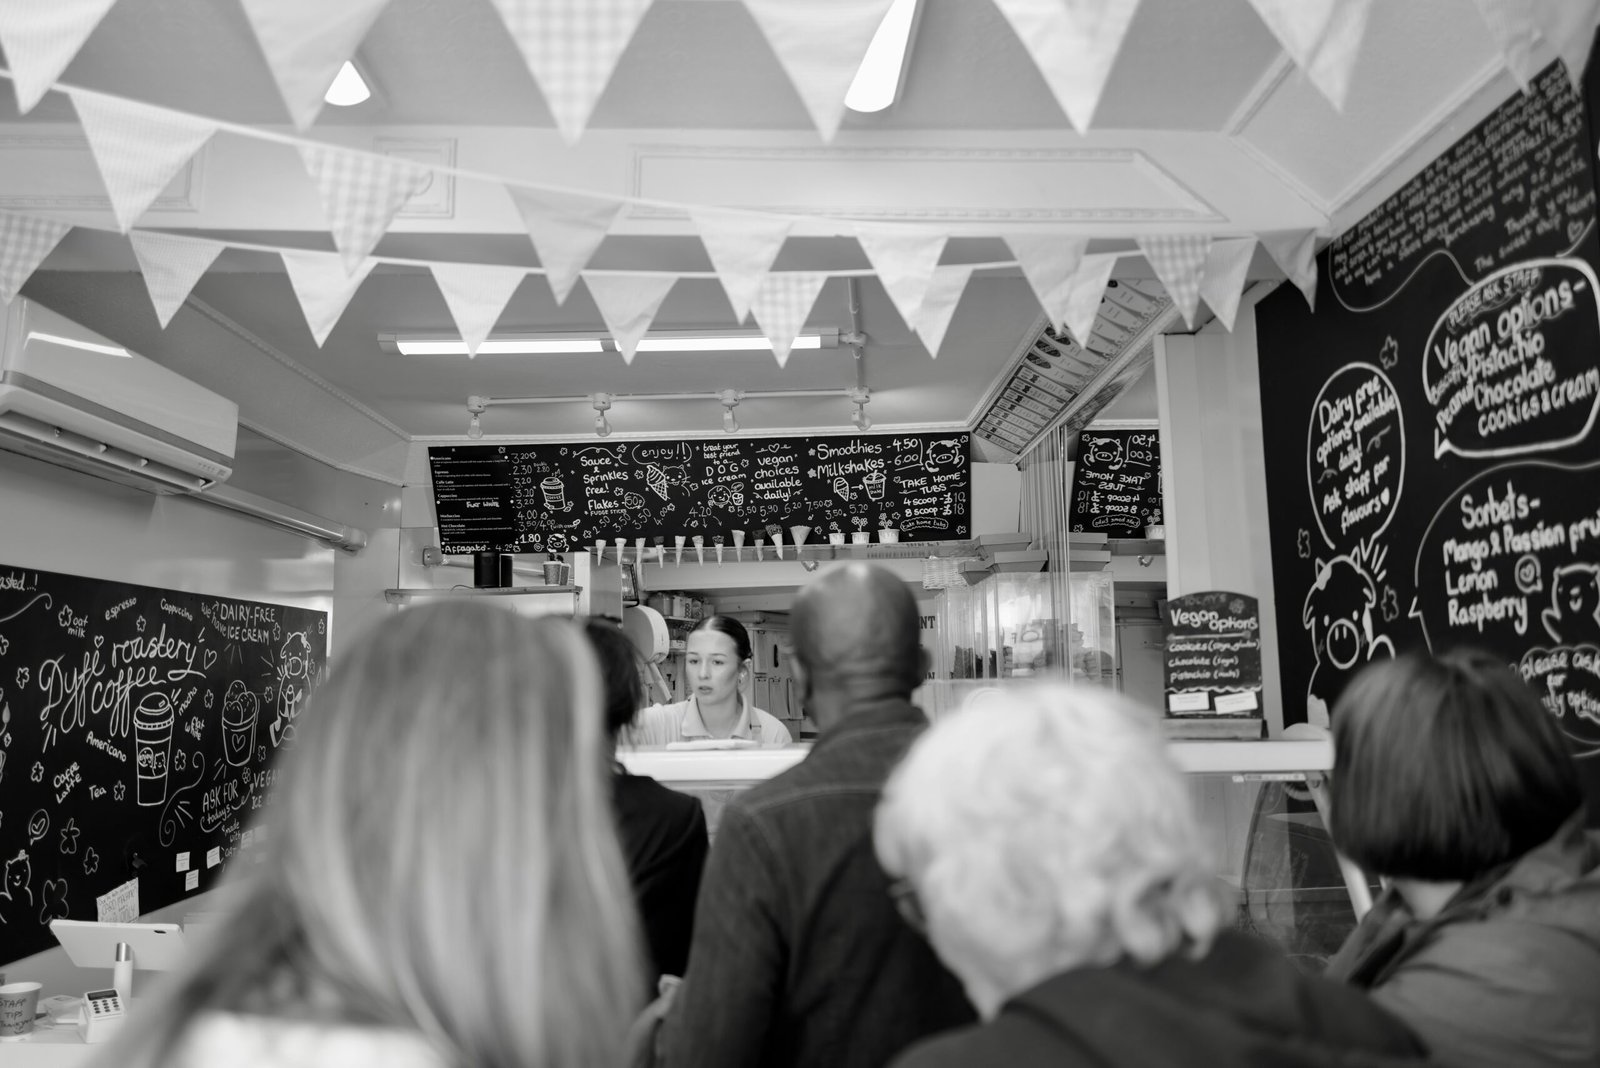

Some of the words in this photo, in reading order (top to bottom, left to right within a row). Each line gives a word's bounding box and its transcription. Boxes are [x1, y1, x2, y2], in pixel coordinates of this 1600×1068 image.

[1504, 268, 1539, 292] STAFF
[1434, 322, 1491, 377] Vegan
[1472, 332, 1545, 381] Pistachio
[1474, 357, 1556, 411] Chocolate
[1478, 396, 1540, 437] cookies
[1551, 367, 1600, 410] cream
[1319, 395, 1354, 433] Dairy
[703, 443, 721, 452] treat
[723, 443, 738, 452] your
[817, 440, 882, 460] Smoothies
[893, 438, 918, 452] 4.50
[1317, 421, 1352, 468] options
[580, 456, 612, 466] Sauce
[719, 449, 741, 459] friend
[758, 455, 793, 466] vegan
[513, 465, 532, 475] 2.30
[755, 465, 799, 479] choices
[817, 458, 885, 479] Milkshakes
[895, 454, 919, 465] 6.00
[583, 470, 629, 485] Sprinkles
[718, 473, 746, 483] cream
[754, 476, 802, 490] available
[900, 477, 927, 488] TAKE
[933, 472, 961, 483] HOME
[585, 483, 610, 497] free!
[763, 488, 792, 501] daily!
[920, 484, 947, 494] TUBS
[587, 499, 619, 511] Flakes
[784, 502, 802, 513] 6.20
[806, 500, 824, 512] 7.50
[878, 501, 895, 511] 7.00
[913, 496, 938, 505] scoop
[517, 510, 537, 520] 4.00
[737, 506, 757, 517] 5.50
[760, 504, 778, 517] 5.90
[825, 509, 843, 520] 3.50
[849, 504, 869, 514] 5.20
[914, 507, 938, 517] scoop
[592, 516, 610, 535] 2.50
[612, 513, 631, 532] 3.50
[632, 508, 651, 529] 3.50
[520, 533, 541, 544] 1.80
[1443, 538, 1489, 572] Mango
[1503, 520, 1565, 554] Passion
[1445, 569, 1498, 596] Lemon
[105, 597, 137, 621] espresso
[160, 598, 193, 622] Cappuccino
[220, 603, 276, 626] DAIRY-FREE
[1448, 592, 1528, 635] Raspberry
[73, 615, 89, 626] oat
[1171, 608, 1219, 628] Vegan
[1209, 616, 1258, 633] options
[68, 626, 86, 638] milk
[227, 625, 240, 640] ICE
[241, 628, 269, 645] CREAM
[112, 623, 207, 681] roastery
[1169, 643, 1208, 652] cookies
[1168, 657, 1210, 667] chocolate
[1170, 670, 1211, 683] pistachio
[178, 686, 198, 716] mocha
[84, 735, 127, 763] Americano
[89, 784, 107, 800] Tea
[202, 785, 221, 813] ASK
[223, 779, 238, 803] FOR
